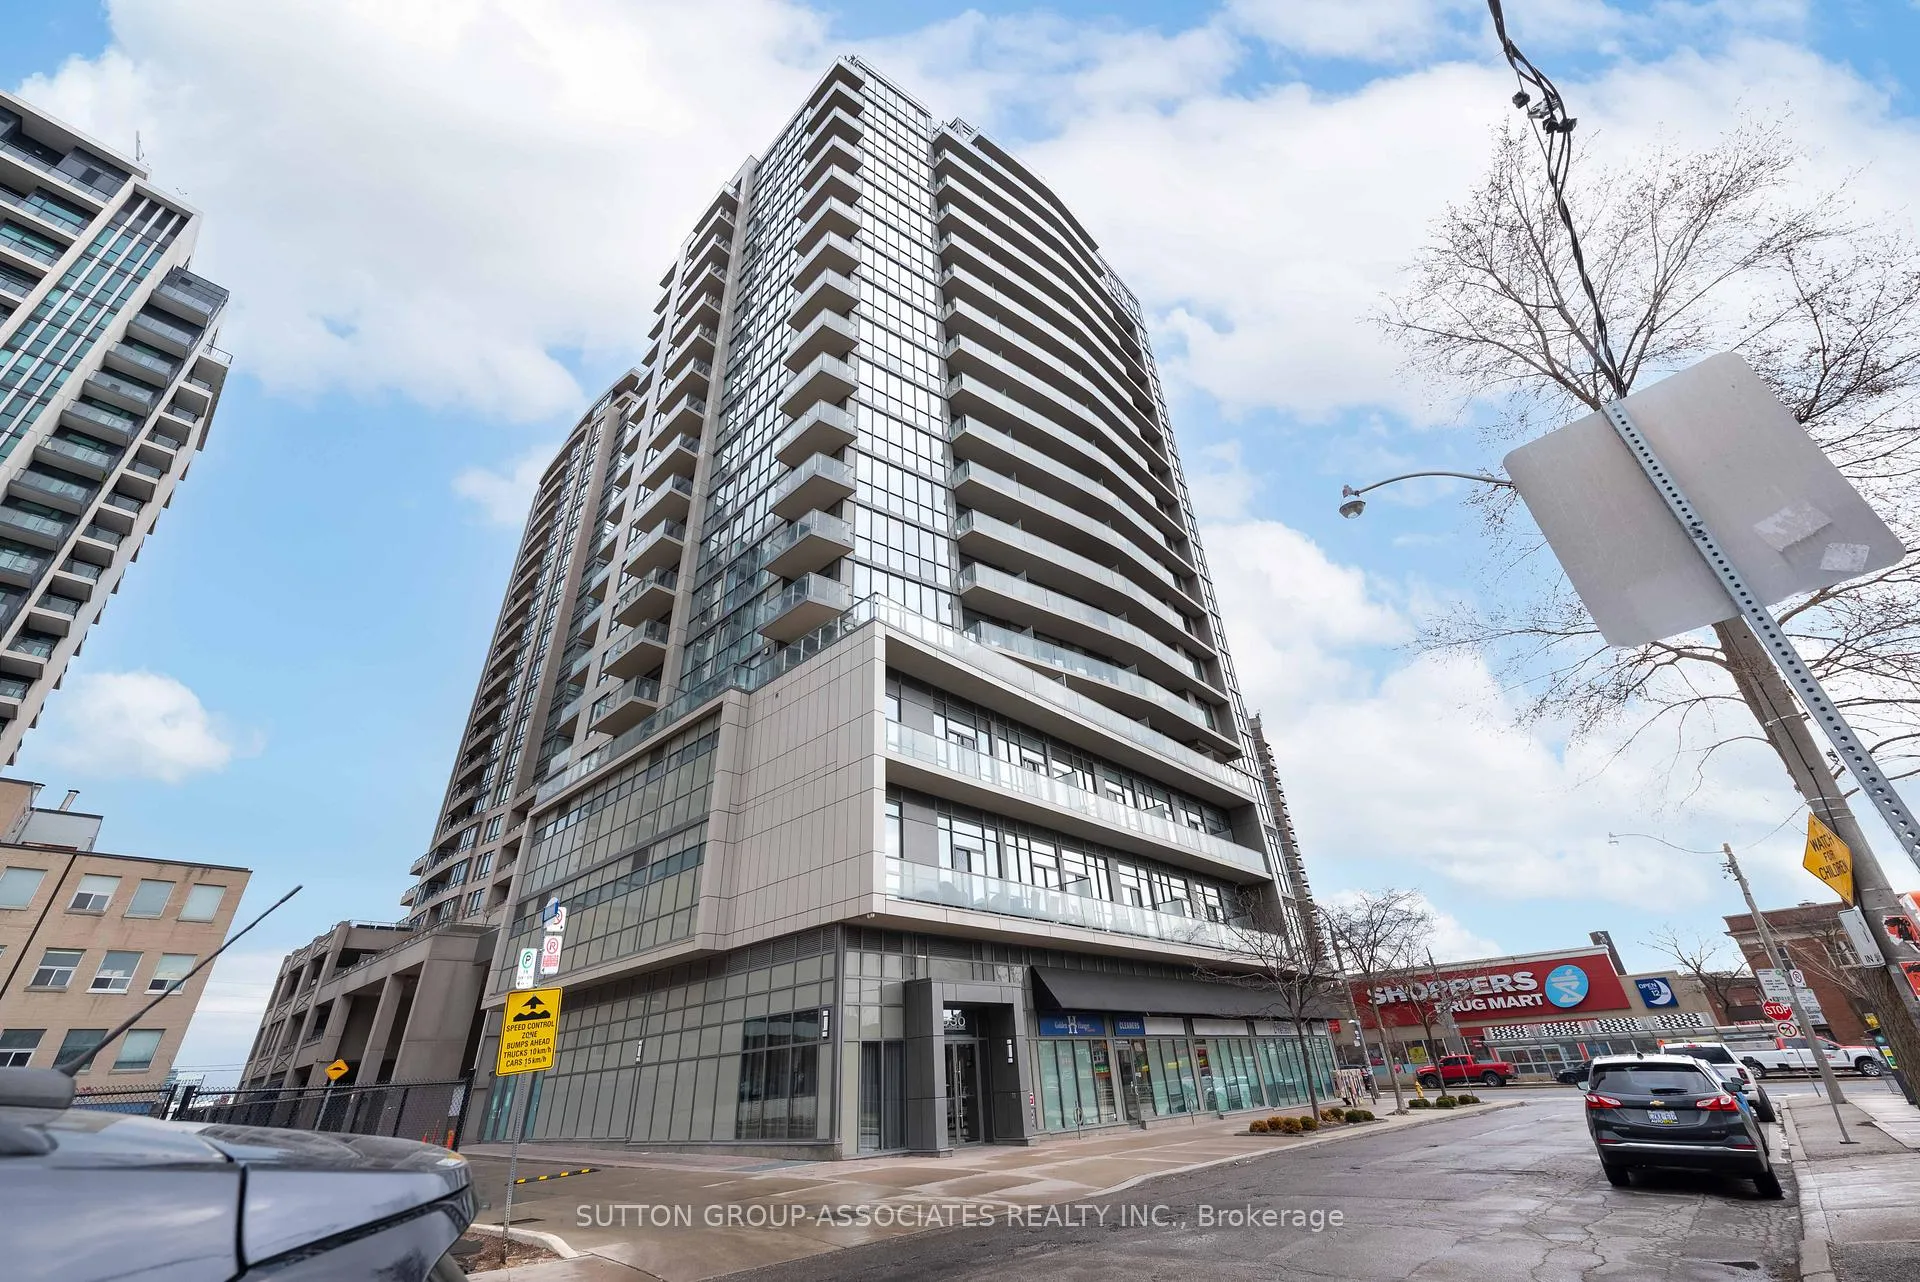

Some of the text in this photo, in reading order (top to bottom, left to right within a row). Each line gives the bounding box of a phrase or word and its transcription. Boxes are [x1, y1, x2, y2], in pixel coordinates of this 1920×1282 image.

[1809, 832, 1835, 852] WATCH
[1822, 849, 1837, 862] FOR
[1818, 858, 1850, 880] CHILDREN
[1366, 971, 1539, 1005] SHOPPERS
[1487, 993, 1544, 1010] MART
[1765, 1005, 1789, 1015] STOP
[505, 1020, 555, 1032] SPEED CONTROL
[1118, 1021, 1141, 1030] CLEANERS
[521, 1031, 538, 1039] ZONE
[506, 1038, 551, 1049] BUMPS AHEAD
[503, 1049, 528, 1059] TRUCKS
[505, 1058, 523, 1068] CARS
